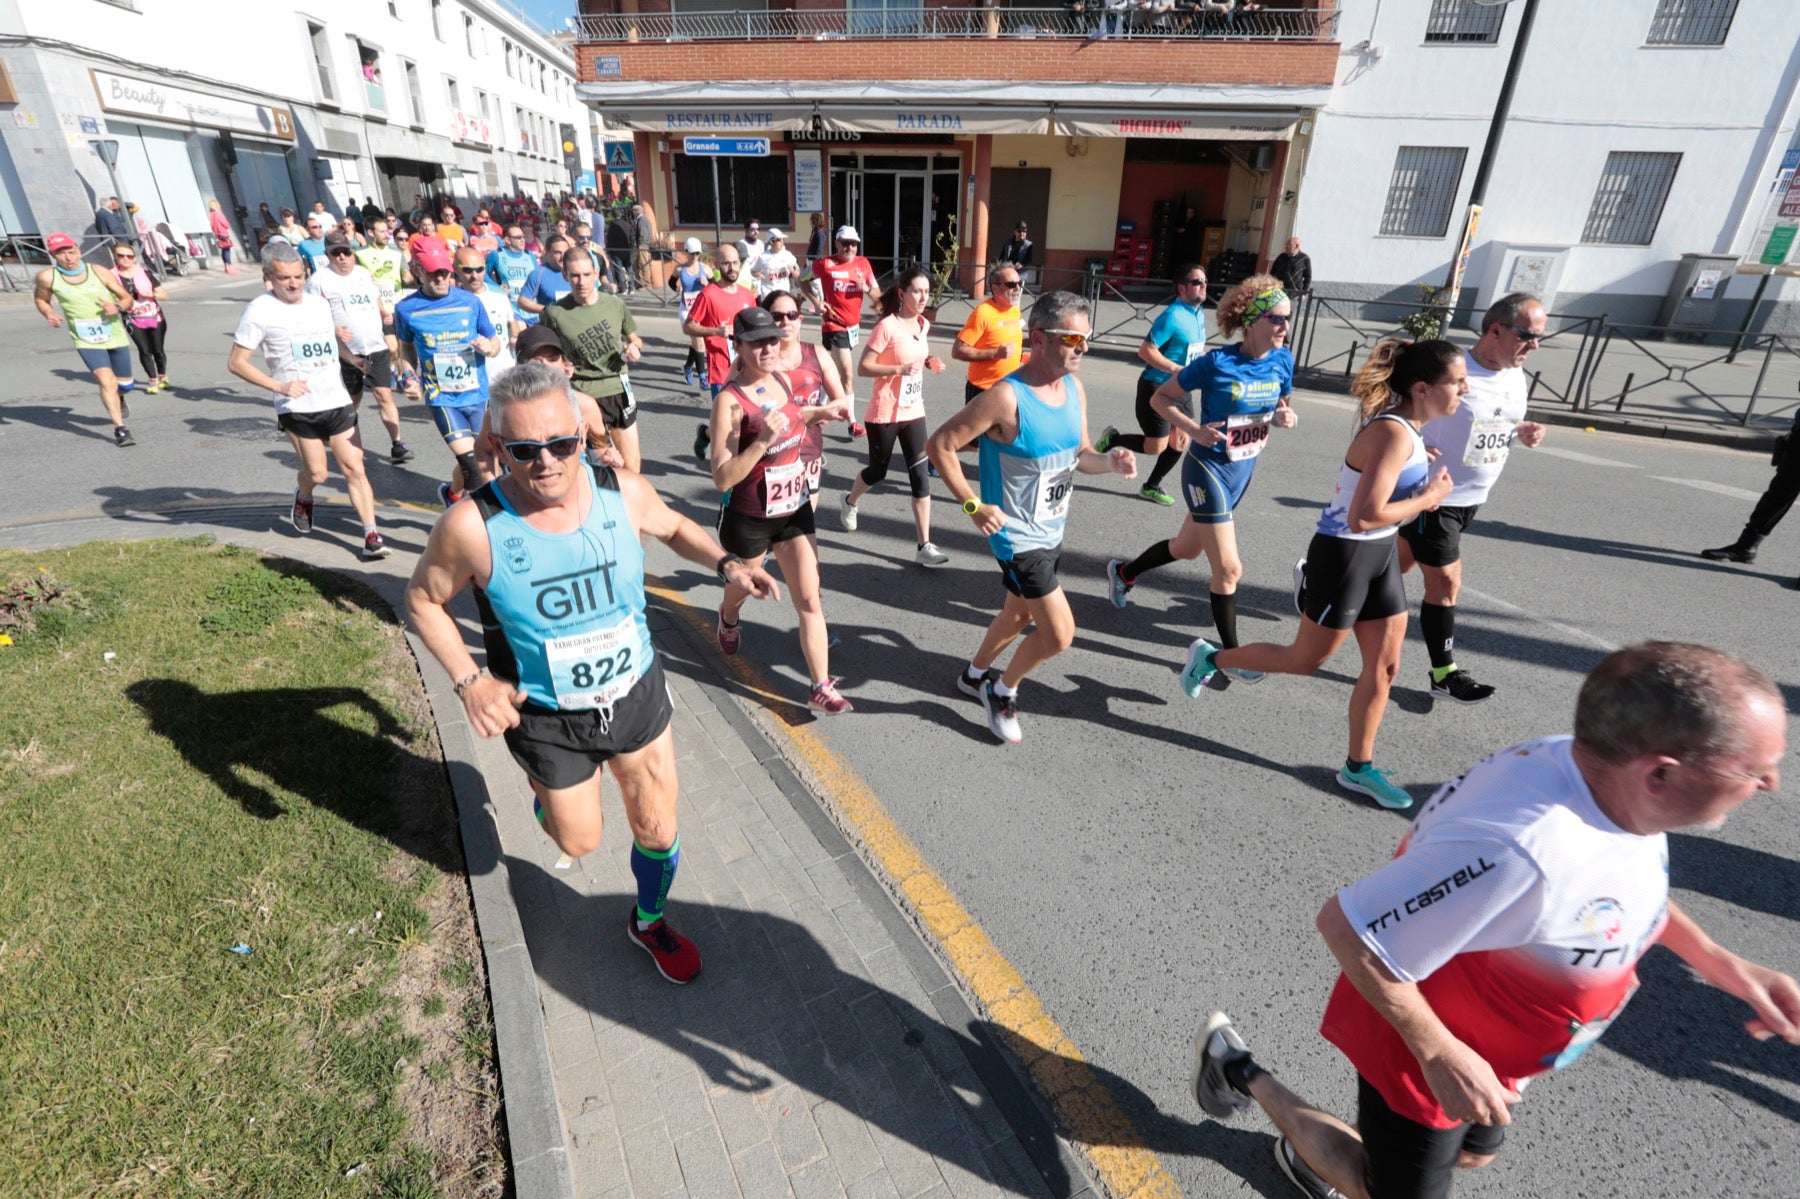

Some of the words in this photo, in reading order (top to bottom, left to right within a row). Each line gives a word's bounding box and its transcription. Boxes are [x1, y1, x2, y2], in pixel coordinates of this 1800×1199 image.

[109, 78, 167, 114] Beauty
[278, 113, 290, 134] B
[666, 113, 774, 129] RESTAURANTE
[897, 113, 963, 129] PARADA
[791, 128, 861, 141] BICHITOS
[686, 142, 720, 151] Granada
[88, 326, 104, 336] 31
[577, 319, 611, 344] BENE
[302, 341, 333, 358] 894
[445, 364, 471, 379] 424
[531, 561, 617, 621] GIIT
[571, 648, 632, 688] 822
